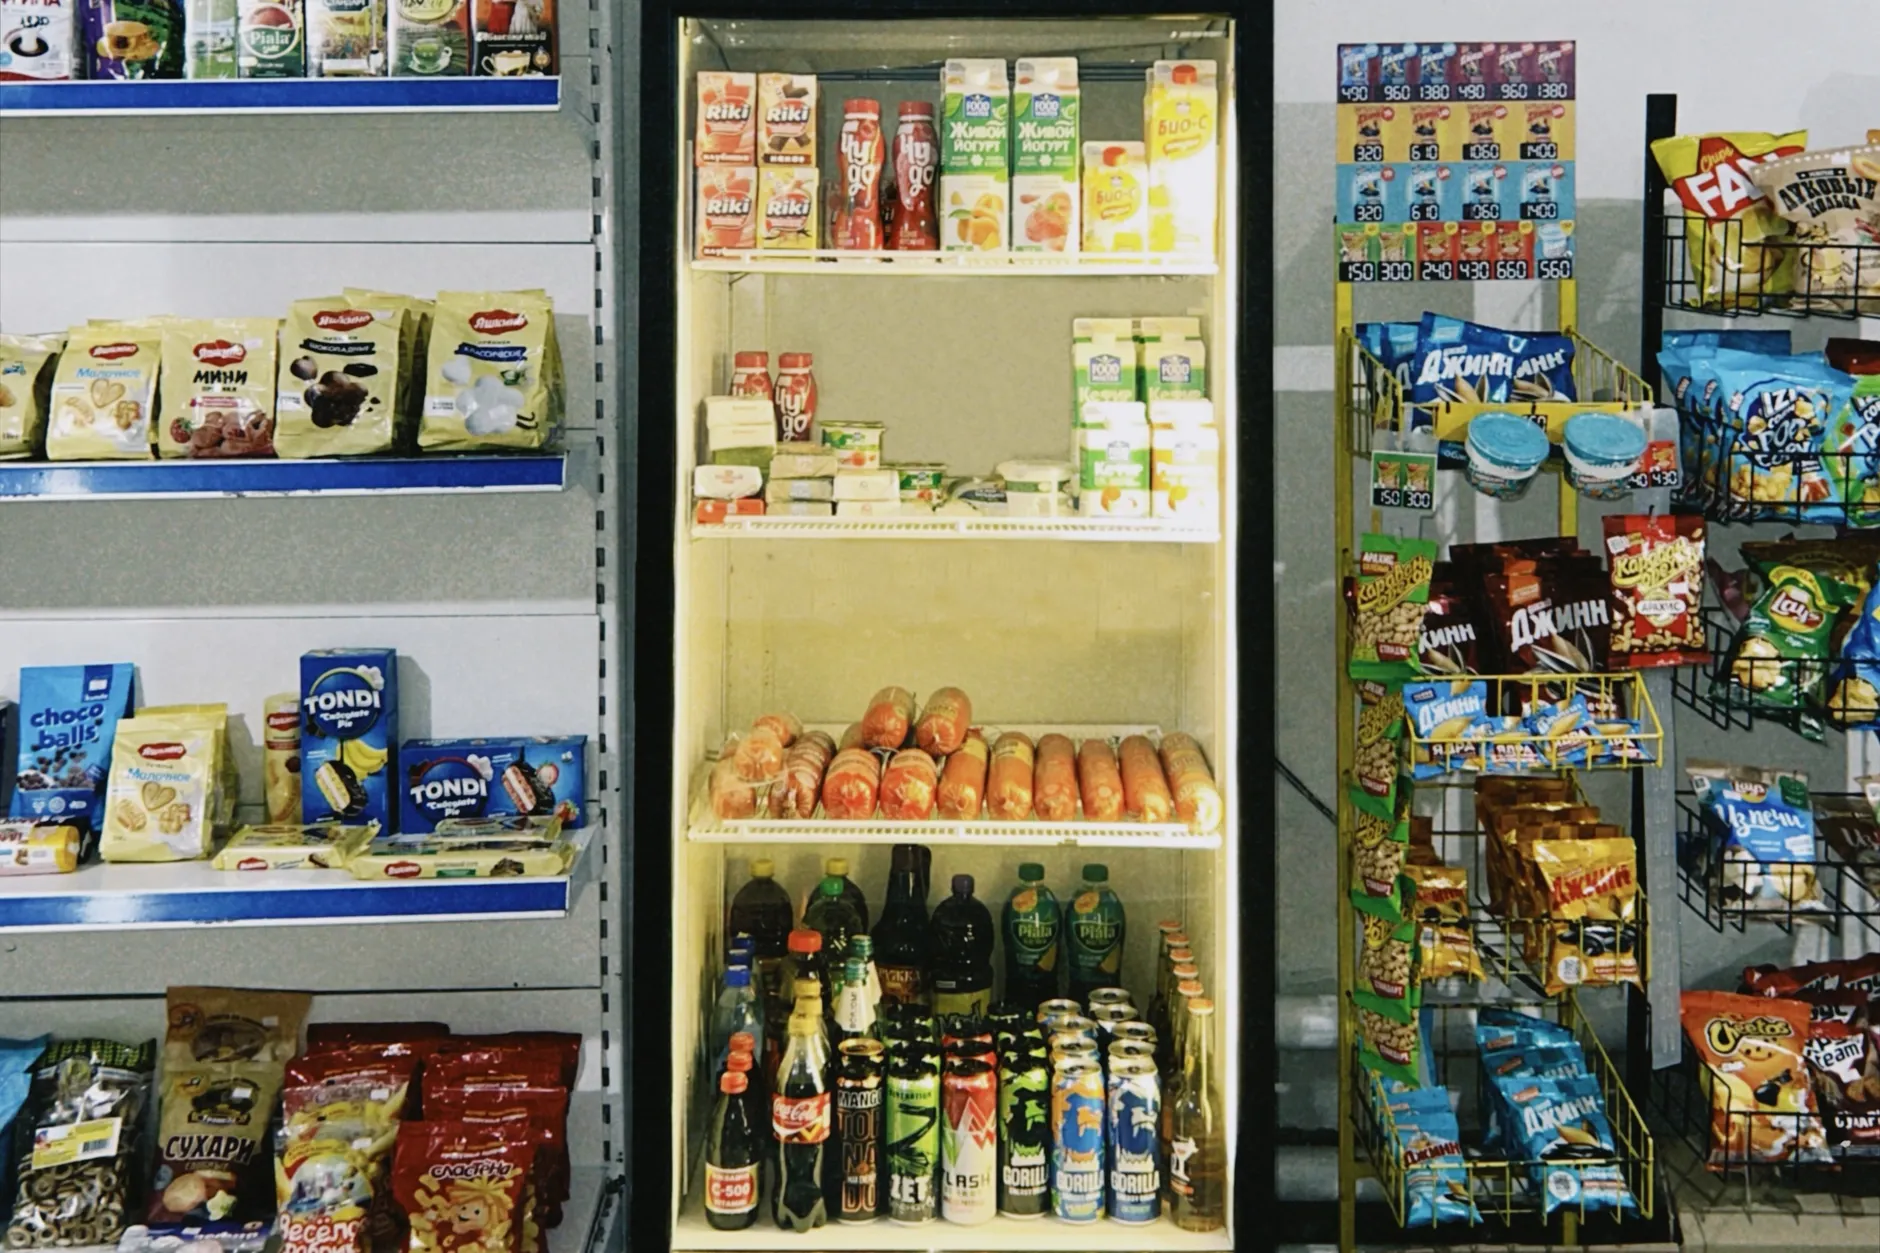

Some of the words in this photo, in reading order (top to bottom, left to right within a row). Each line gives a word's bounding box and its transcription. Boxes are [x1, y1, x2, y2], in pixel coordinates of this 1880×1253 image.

[1341, 86, 1368, 101] 490
[1384, 85, 1411, 100] 960
[1420, 85, 1450, 100] 1380
[1458, 84, 1485, 99] 490
[1501, 84, 1528, 98] 960
[1538, 83, 1567, 98] 1380
[706, 103, 750, 121] Riki
[766, 104, 810, 123] Riki
[1357, 146, 1382, 160] 320
[1469, 146, 1499, 159] 1060
[1778, 177, 1878, 212] ЛУКОВЫЕ
[706, 197, 751, 215] Riki
[766, 198, 811, 216] Riki
[1357, 206, 1382, 220] 320
[1805, 197, 1861, 218] КОЛЬЦА
[1348, 263, 1374, 280] 150
[1381, 263, 1412, 281] 300
[1422, 263, 1452, 279] 240
[1459, 262, 1489, 278] 430
[1497, 262, 1527, 279] 660
[1540, 261, 1570, 278] 560
[193, 370, 248, 385] МИНИ
[1629, 473, 1648, 487] 40
[1651, 472, 1678, 486] 430
[1406, 491, 1431, 507] 300
[304, 689, 381, 715] TONDI
[30, 703, 104, 727] choco
[38, 724, 98, 749] balls
[410, 777, 488, 804] TONDI
[1705, 1017, 1794, 1056] Cheetos
[164, 1135, 257, 1166] СУХАРИ
[938, 1170, 990, 1189] LASH
